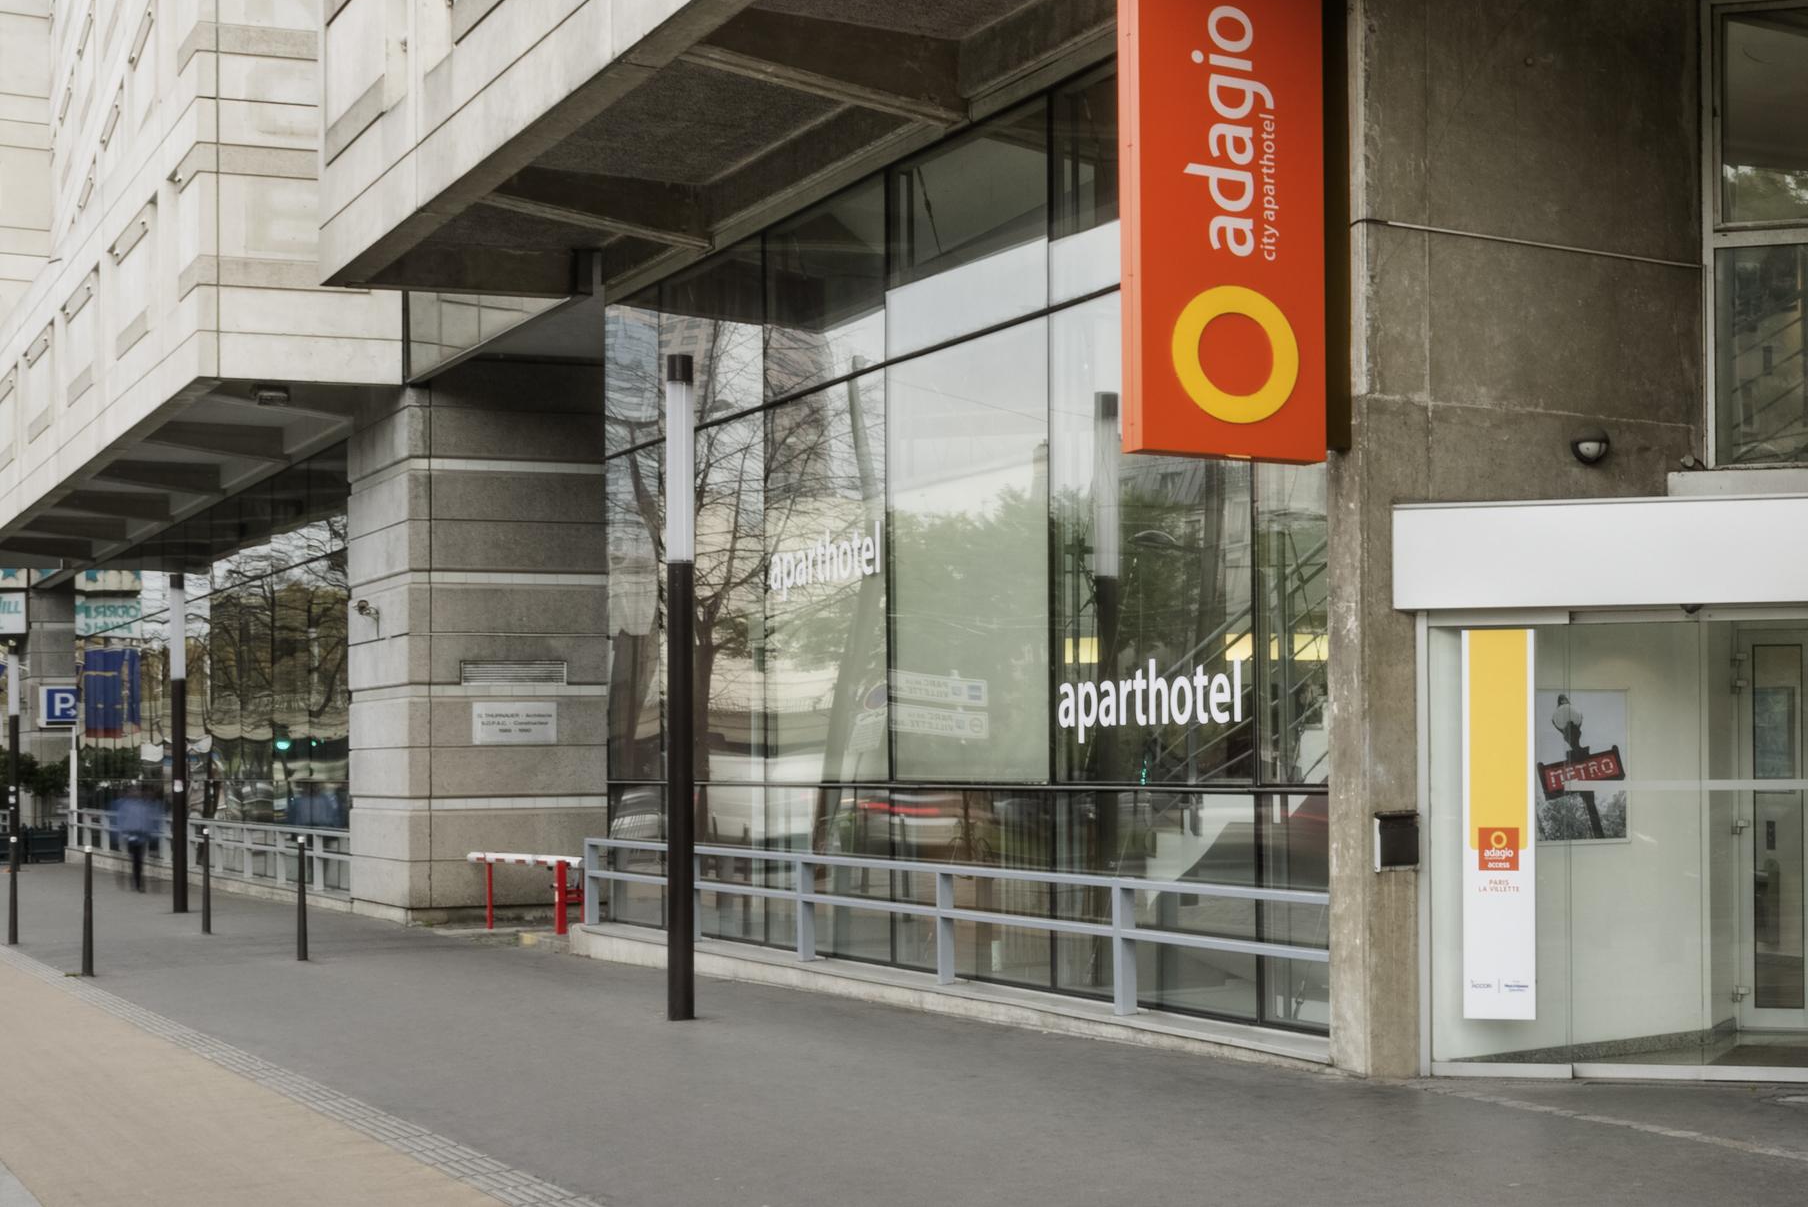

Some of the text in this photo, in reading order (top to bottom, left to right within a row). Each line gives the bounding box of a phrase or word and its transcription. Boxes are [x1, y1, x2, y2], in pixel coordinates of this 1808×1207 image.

[1183, 5, 1275, 257] adagio
[1259, 113, 1280, 261] city aparthotel
[769, 520, 881, 601] aparthotel
[54, 692, 75, 716] P
[1058, 658, 1242, 743] aparthotel
[1550, 758, 1613, 788] METRO
[1484, 847, 1514, 859] adagio
